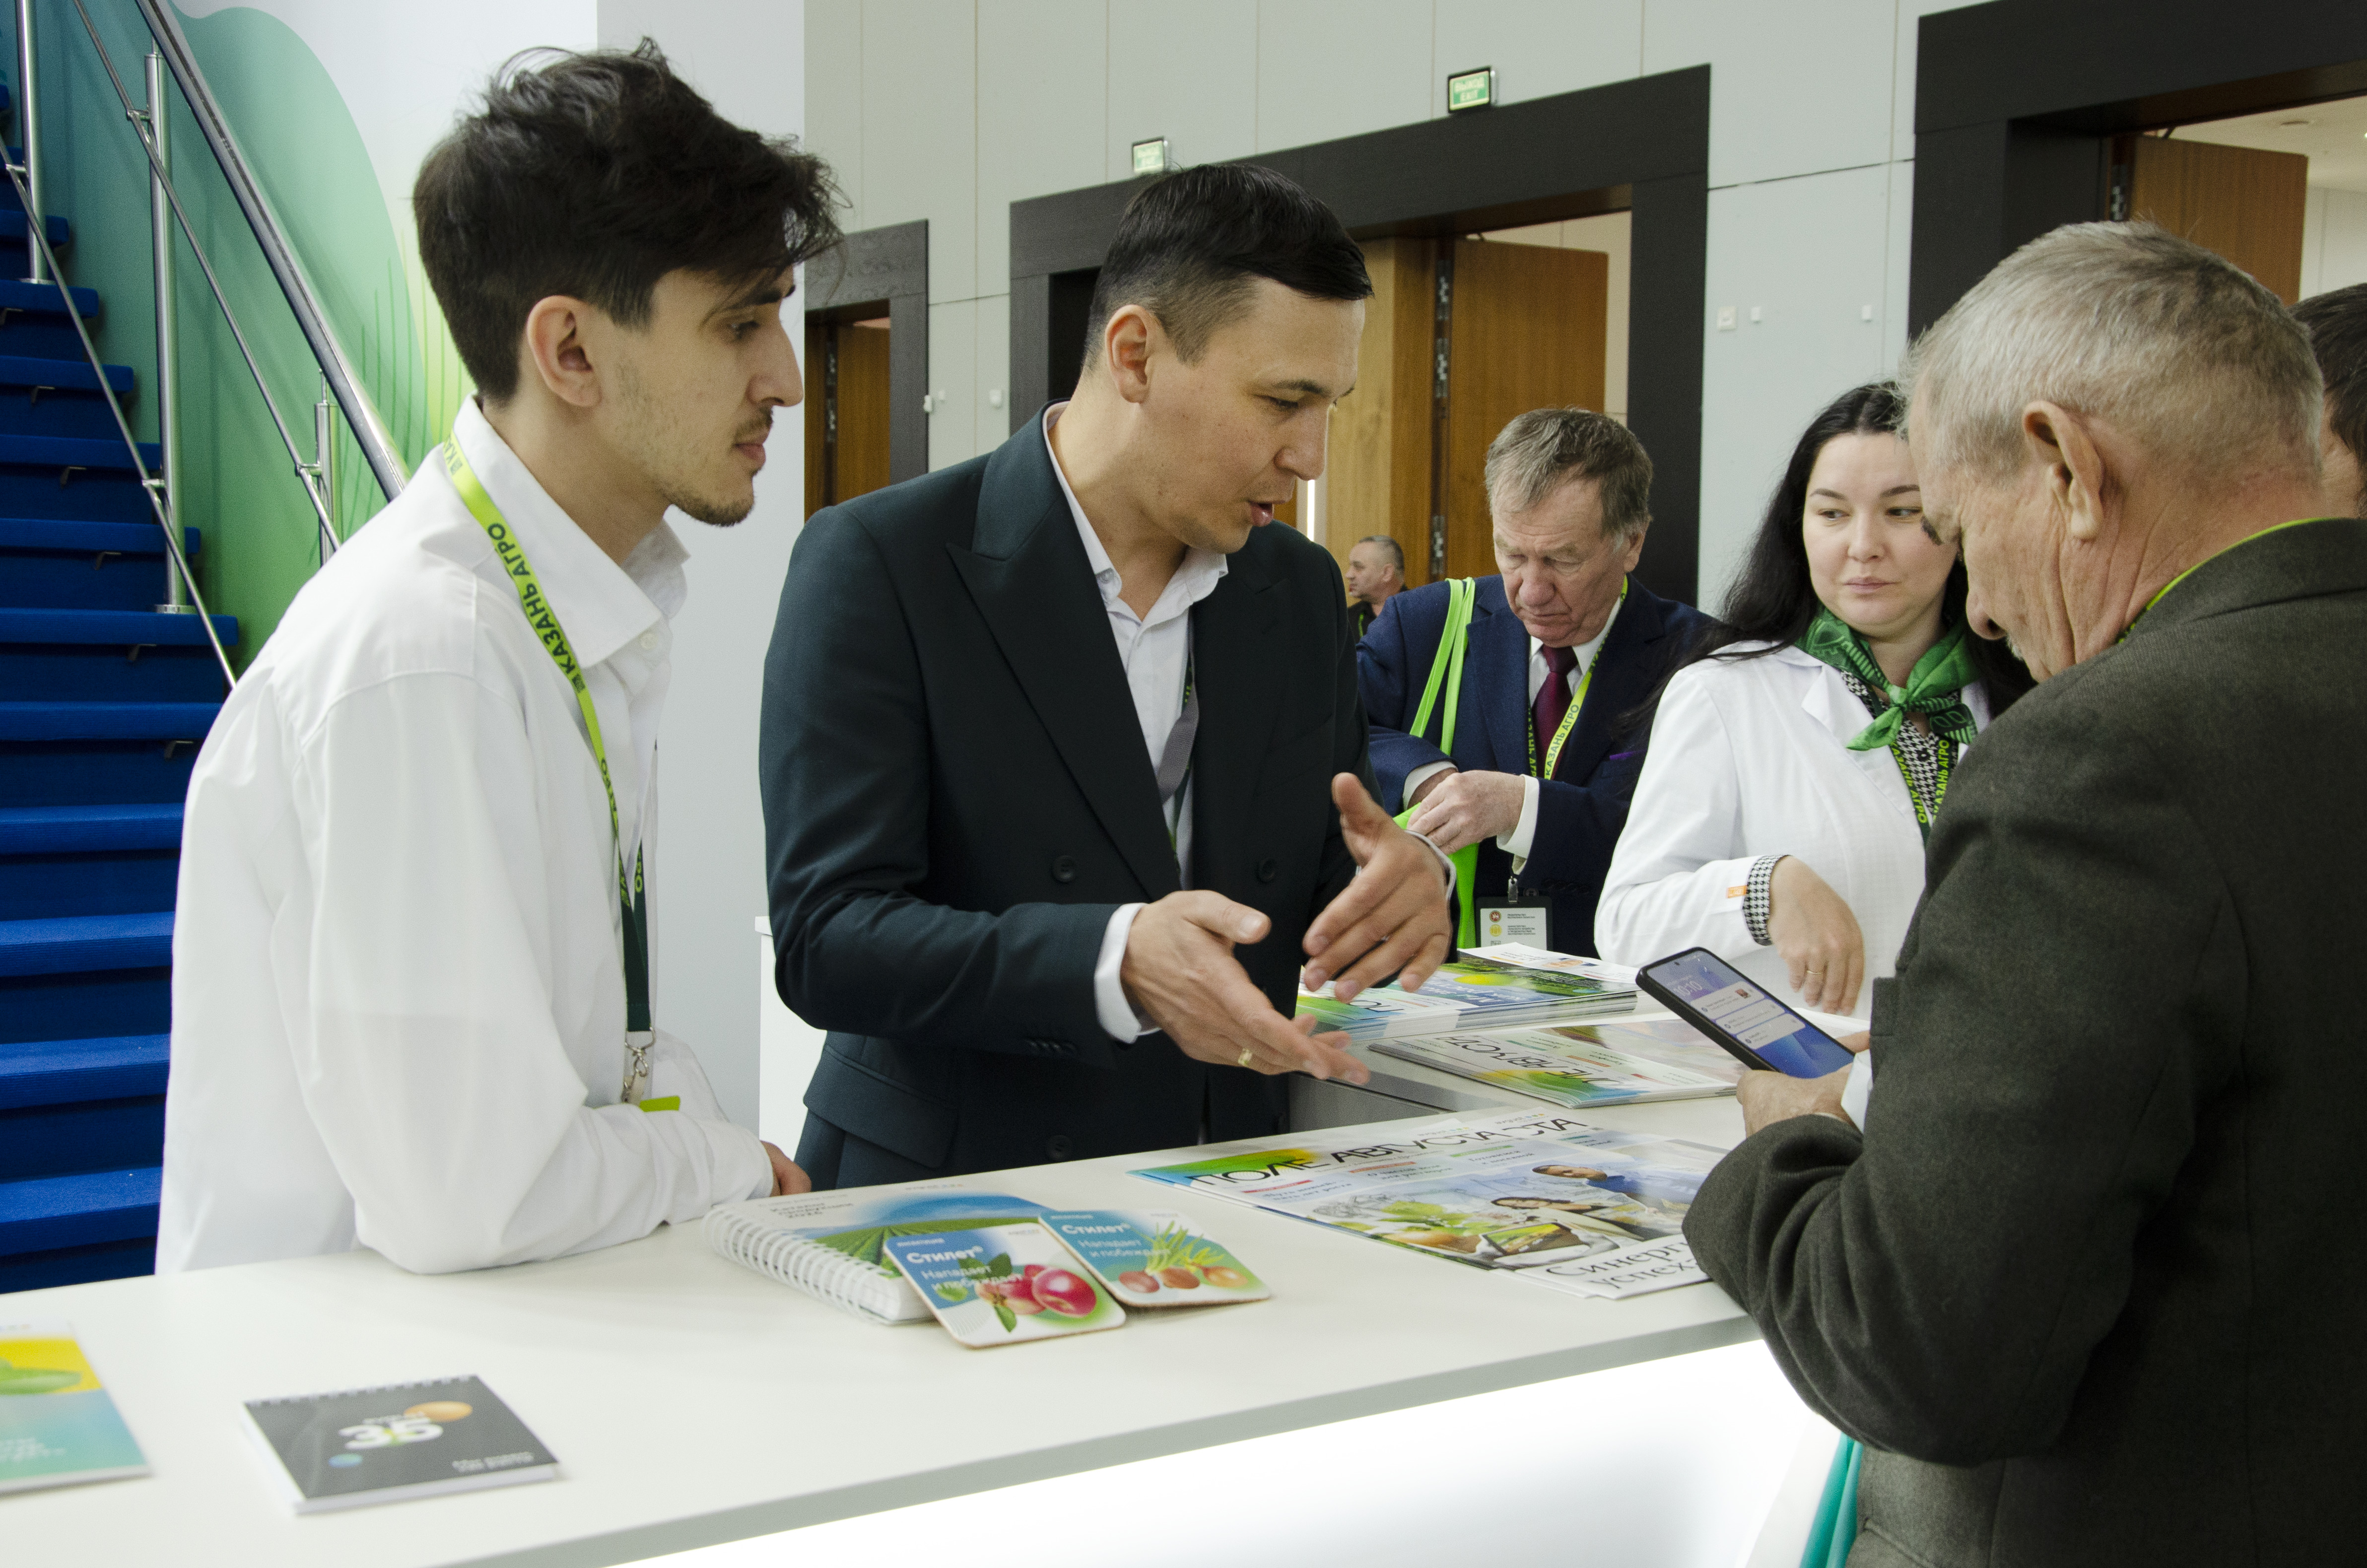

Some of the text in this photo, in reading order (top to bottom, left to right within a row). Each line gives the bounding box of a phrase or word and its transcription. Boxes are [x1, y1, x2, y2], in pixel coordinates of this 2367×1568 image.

[487, 523, 575, 674] КАЗАНЬ АГРО
[1546, 704, 1580, 776] КАЗАНЬ АГРО
[1938, 740, 1950, 768] АГРО
[1910, 790, 1928, 823] АГРО
[1434, 1035, 1568, 1068] АВГУСТА
[1185, 1158, 1331, 1186] ПОЛЕ
[1331, 1130, 1513, 1163] АВГУСТА
[920, 1264, 993, 1280] Нападает
[338, 1417, 444, 1450] 35
